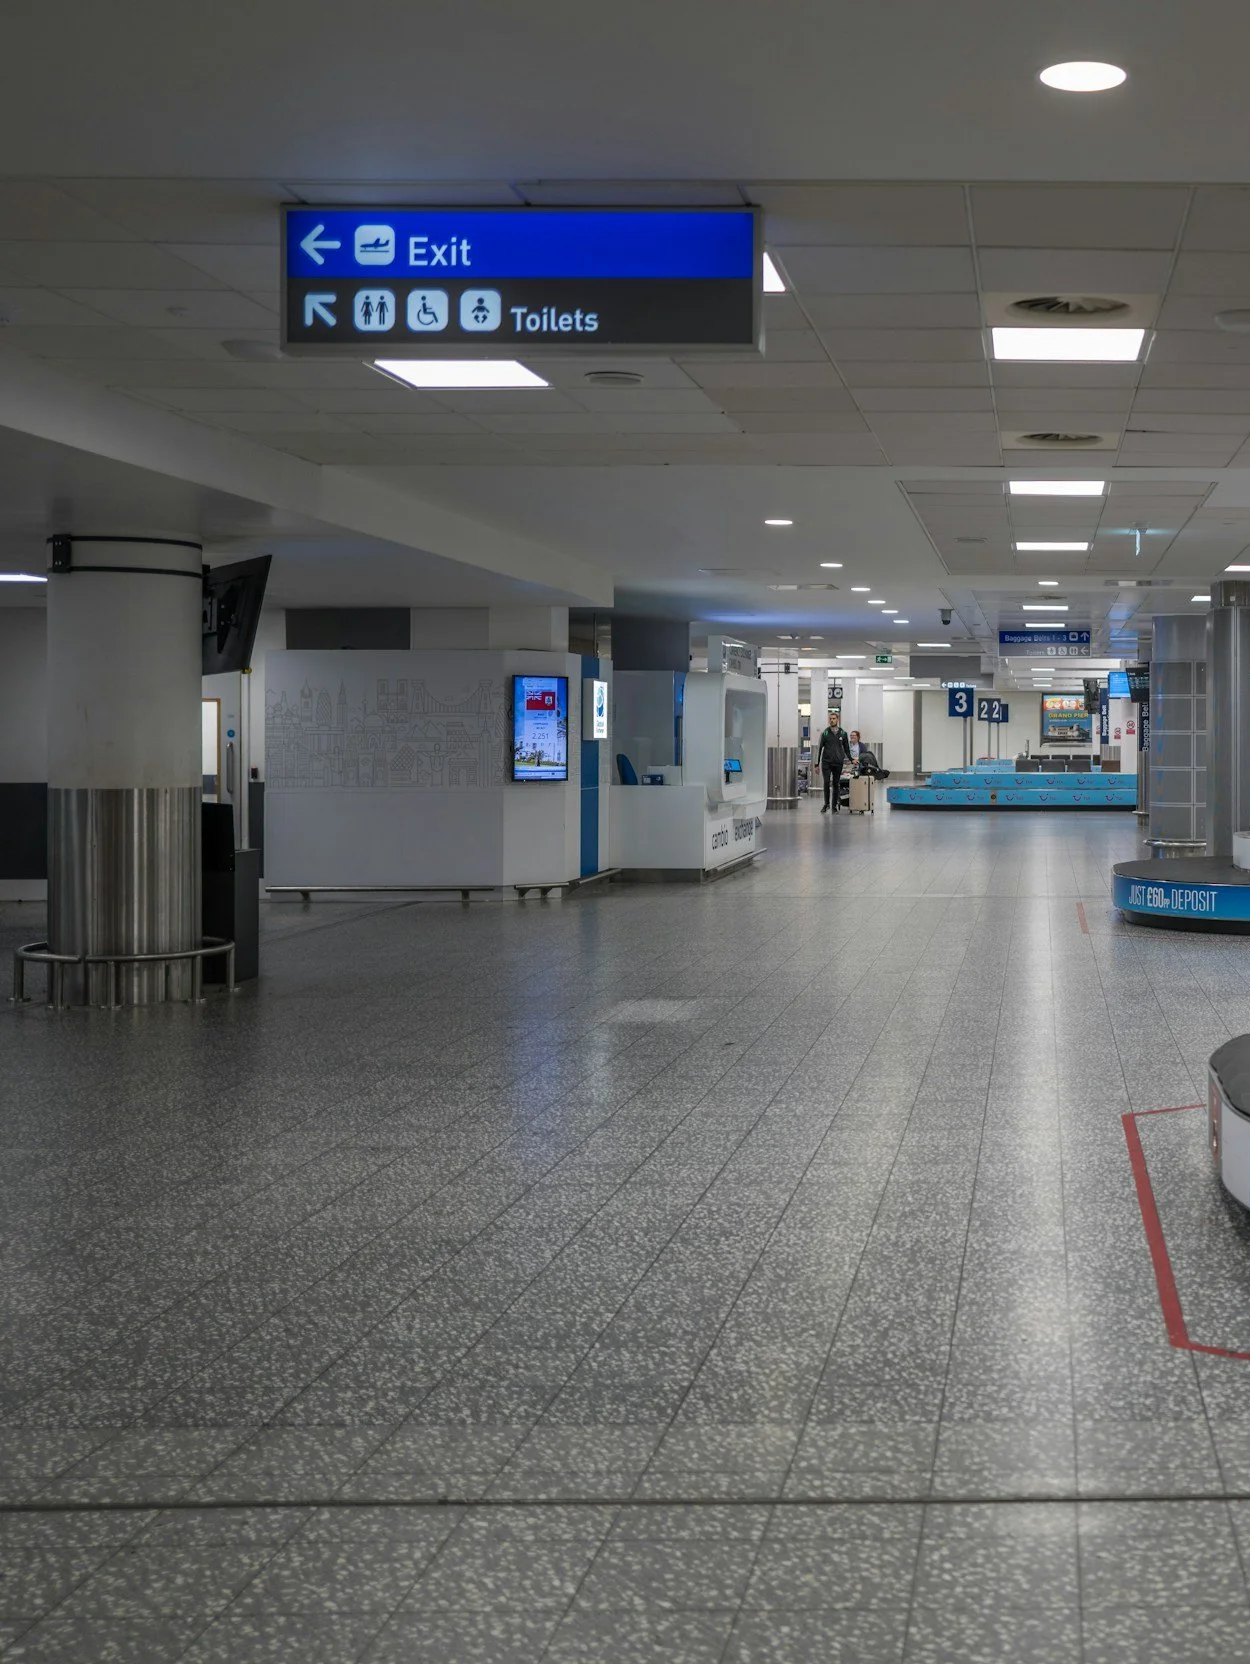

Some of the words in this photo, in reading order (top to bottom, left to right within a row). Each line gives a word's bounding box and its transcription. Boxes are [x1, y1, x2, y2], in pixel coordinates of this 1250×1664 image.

[408, 236, 472, 266] Exit
[510, 305, 599, 333] Toilets
[1004, 634, 1032, 643] Baggage
[1033, 634, 1050, 642] Belts
[954, 691, 968, 713] 3
[980, 700, 988, 718] 2
[992, 700, 999, 718] 2
[1141, 719, 1150, 752] Baggage
[711, 823, 729, 850] cambio
[735, 820, 753, 842] exchange
[1128, 884, 1147, 907] JUST
[1171, 888, 1219, 912] DEPOSIT
